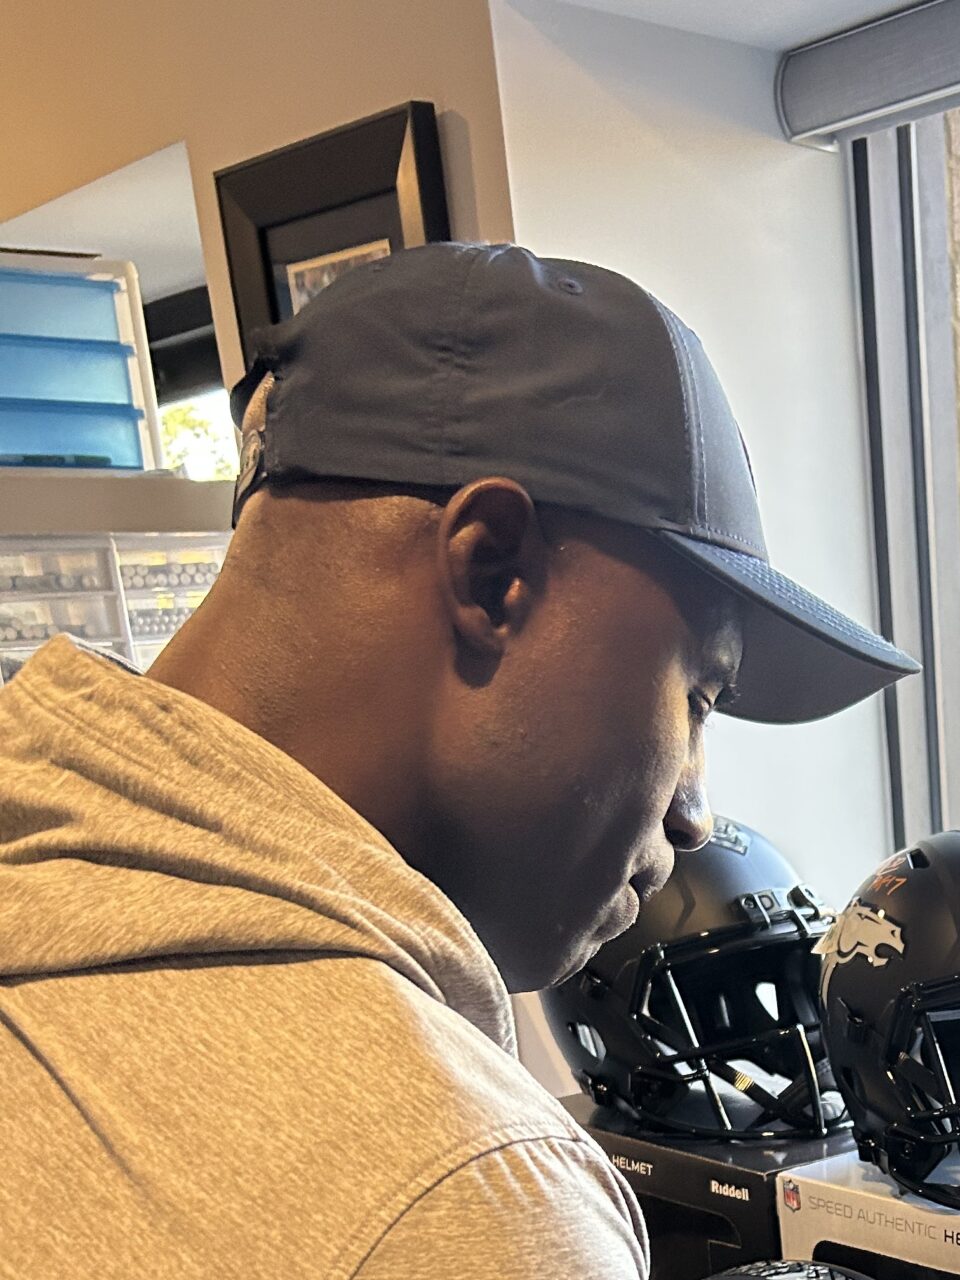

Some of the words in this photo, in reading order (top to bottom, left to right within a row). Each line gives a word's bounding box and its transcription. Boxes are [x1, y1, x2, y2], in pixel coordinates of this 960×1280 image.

[612, 1154, 653, 1176] HELMET
[710, 1180, 750, 1201] Riddell
[808, 1195, 853, 1219] SPEED
[857, 1208, 937, 1240] AUTHENTIC
